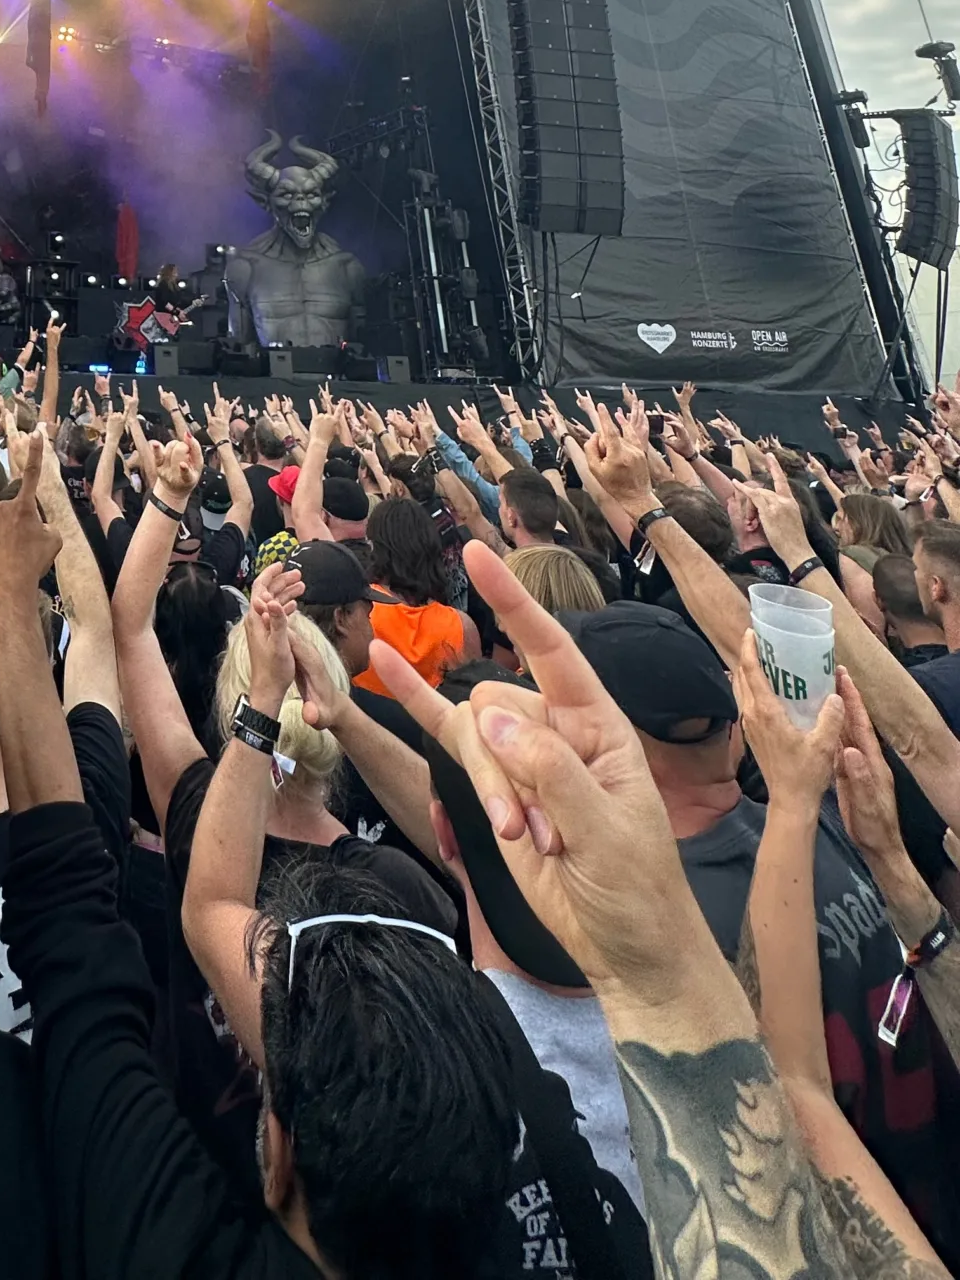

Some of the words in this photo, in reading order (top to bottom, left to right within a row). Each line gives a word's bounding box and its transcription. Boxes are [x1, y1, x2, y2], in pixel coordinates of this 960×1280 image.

[690, 331, 727, 340] HAMBURG
[751, 330, 772, 342] OPEN
[774, 331, 788, 342] AIR
[692, 339, 729, 349] KONZERTE
